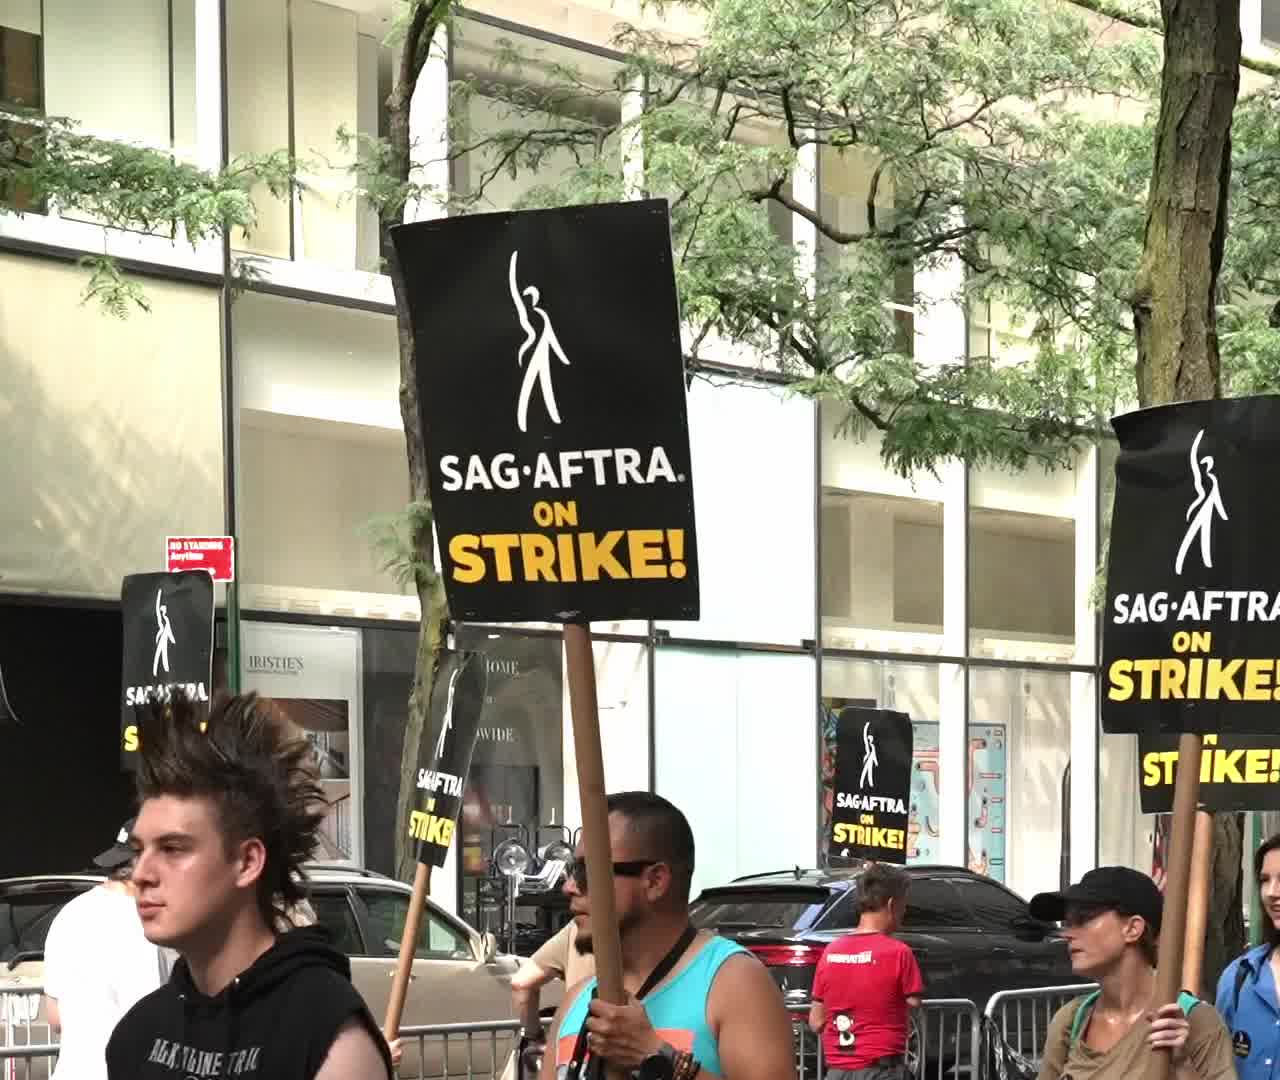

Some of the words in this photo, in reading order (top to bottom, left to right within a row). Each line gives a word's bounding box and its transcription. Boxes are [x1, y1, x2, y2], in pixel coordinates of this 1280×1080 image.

[532, 501, 578, 527] ON
[448, 528, 687, 584] STRIKE!
[1172, 631, 1211, 653] ON
[833, 822, 904, 850] STRIKE!
